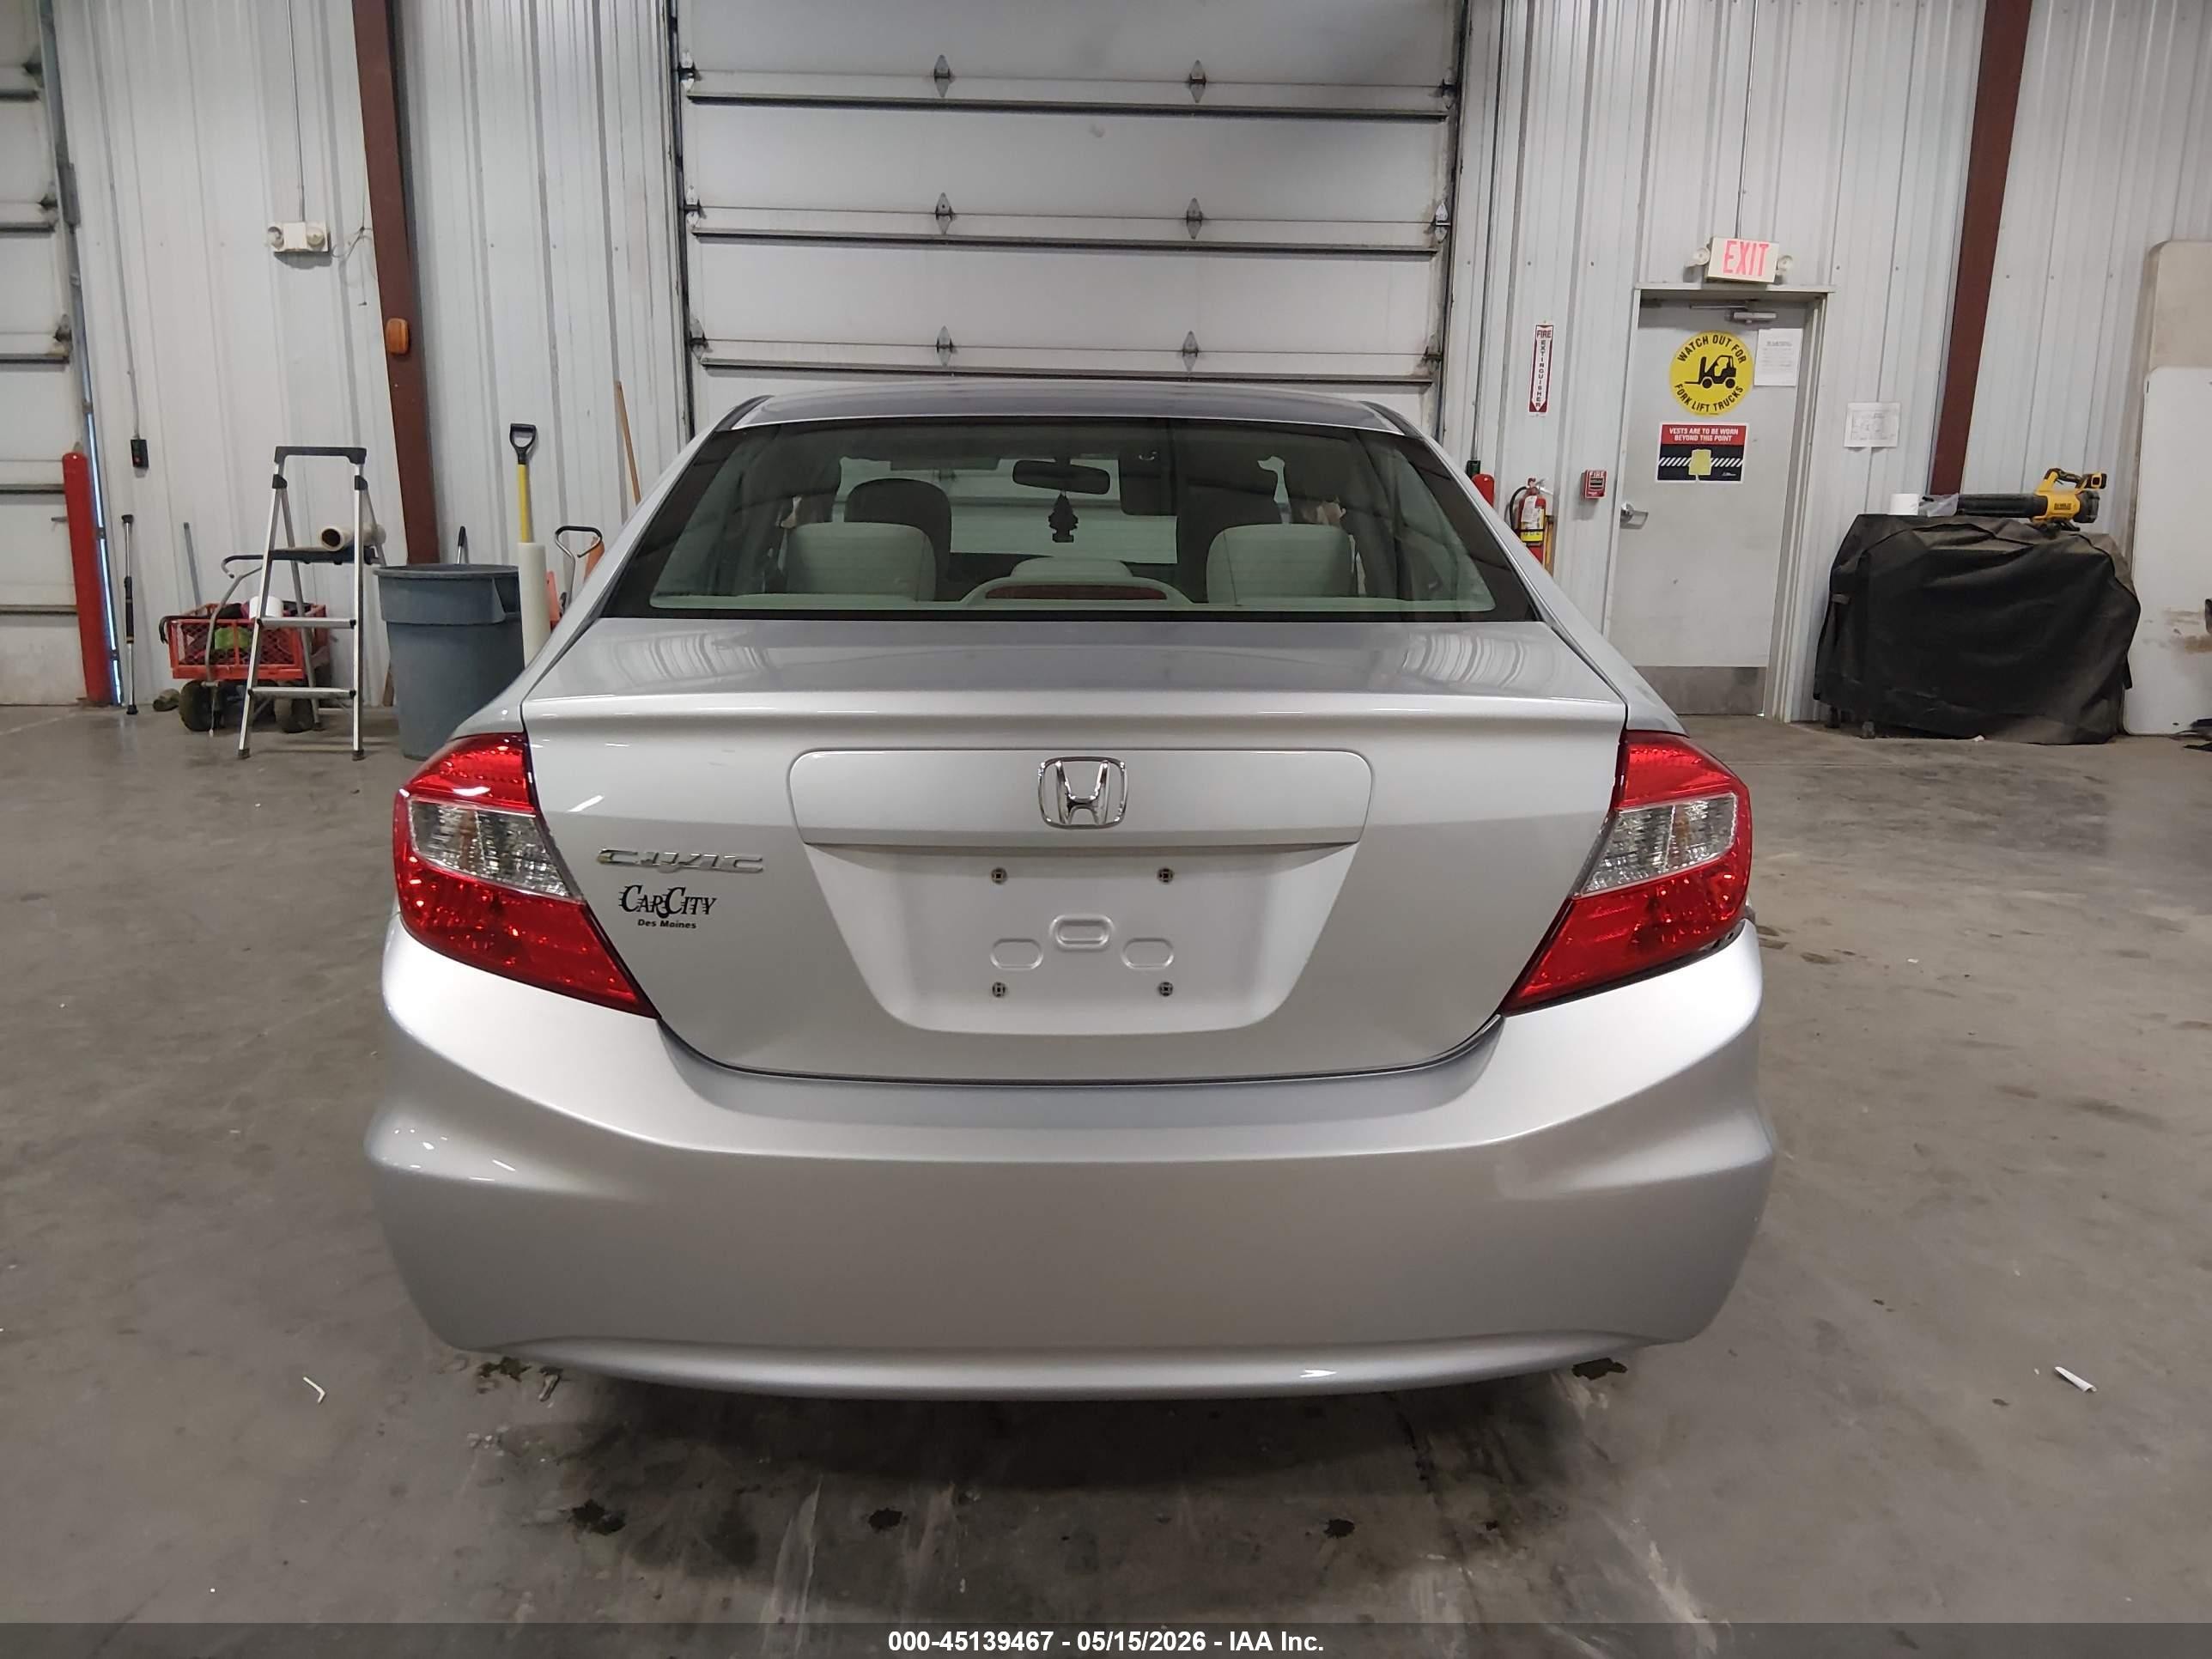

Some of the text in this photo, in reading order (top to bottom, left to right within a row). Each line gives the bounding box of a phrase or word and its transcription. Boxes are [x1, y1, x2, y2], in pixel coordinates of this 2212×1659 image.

[1723, 240, 1769, 276] EXIT
[1536, 330, 1552, 338] FIRE
[1677, 335, 1709, 362] WATCH
[1712, 334, 1732, 348] OUT
[1730, 343, 1747, 364] FOR
[1535, 340, 1546, 408] EXTINGUISHER
[1674, 383, 1744, 412] FORK LIFT TRUCKS
[597, 848, 763, 873] CIVIC
[637, 919, 697, 929] Des Moines
